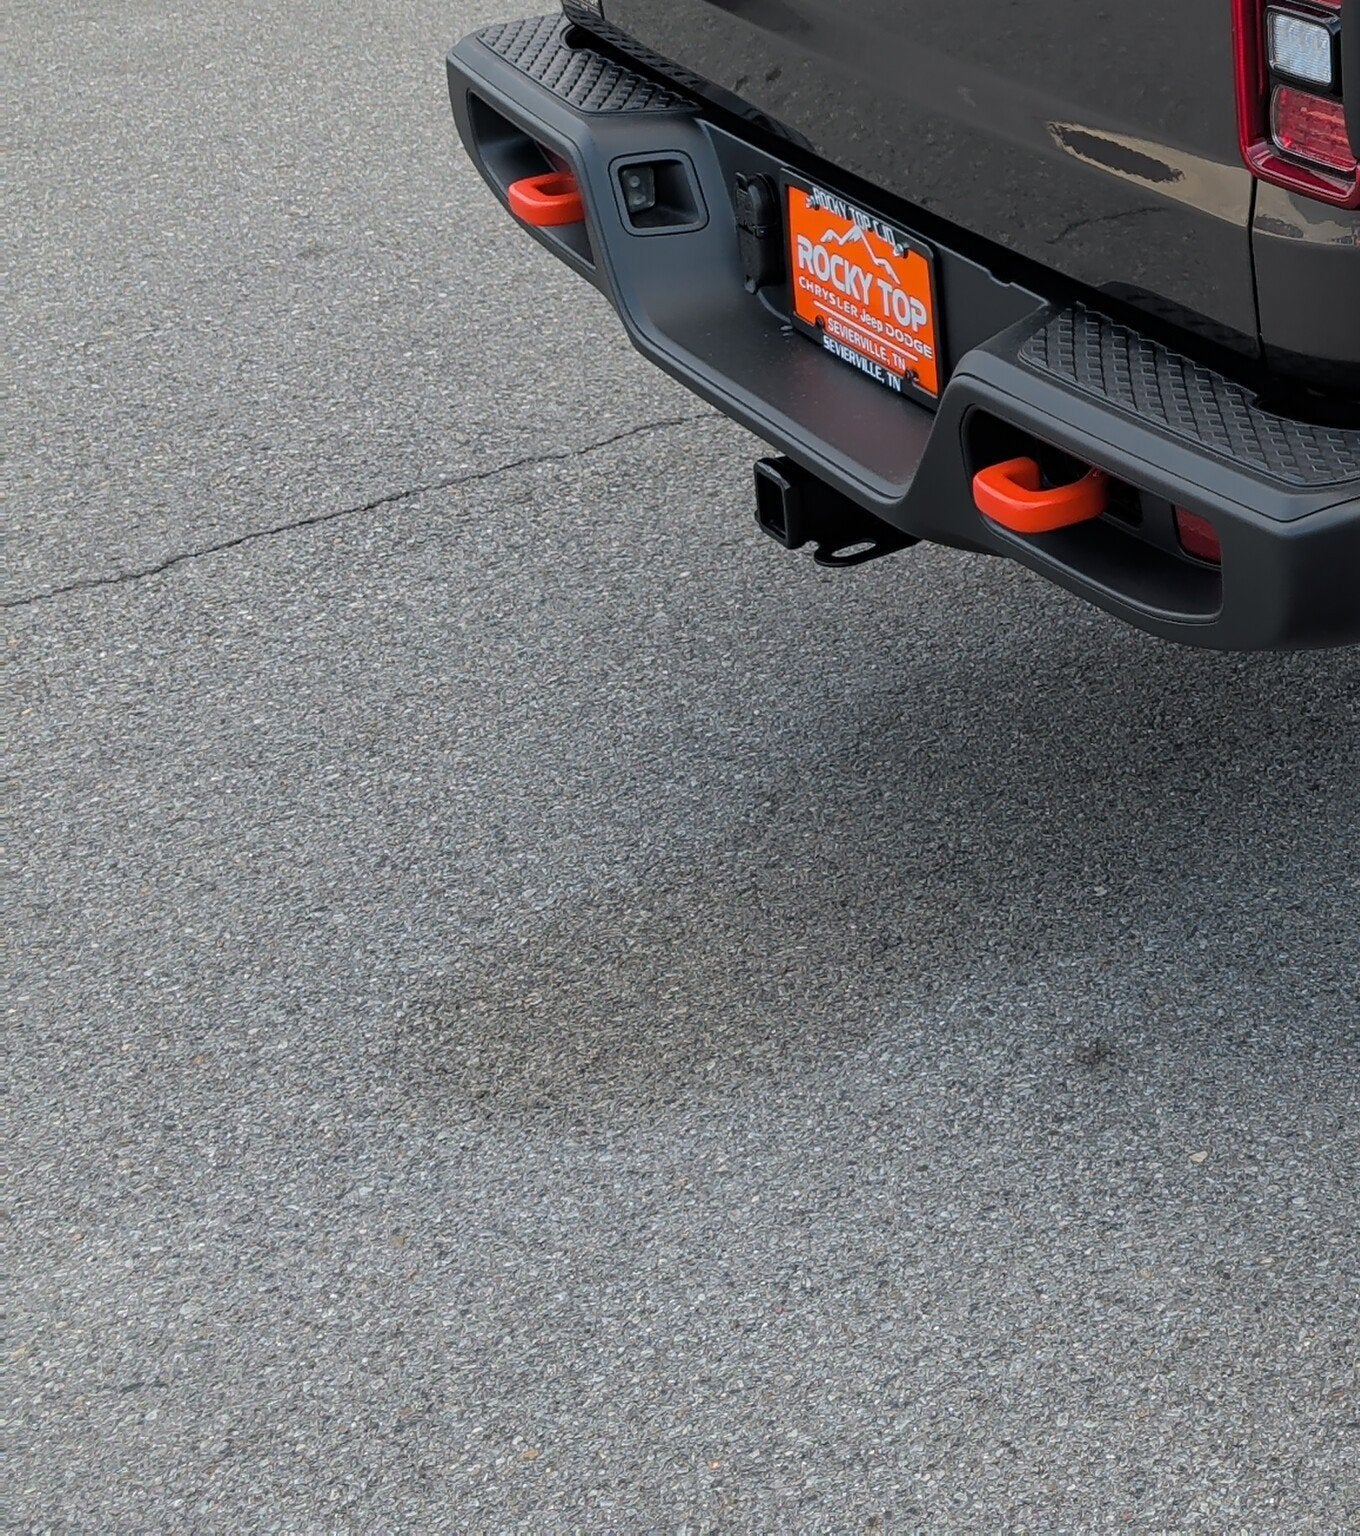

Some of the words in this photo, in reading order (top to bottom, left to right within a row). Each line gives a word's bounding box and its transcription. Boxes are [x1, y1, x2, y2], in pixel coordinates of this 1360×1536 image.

[812, 186, 847, 221] ROCKY
[848, 207, 872, 233] TOP
[873, 222, 896, 246] CJD
[797, 233, 874, 306] ROCKY
[877, 278, 928, 333] TOP
[798, 275, 861, 318] CHRYSLER
[860, 310, 884, 334] Jeep
[885, 321, 934, 360] DODGE
[826, 316, 892, 366] SEVIERVILLE,
[892, 353, 907, 372] TN
[823, 334, 885, 383] SEVIERVILLE,
[887, 371, 901, 393] TN
